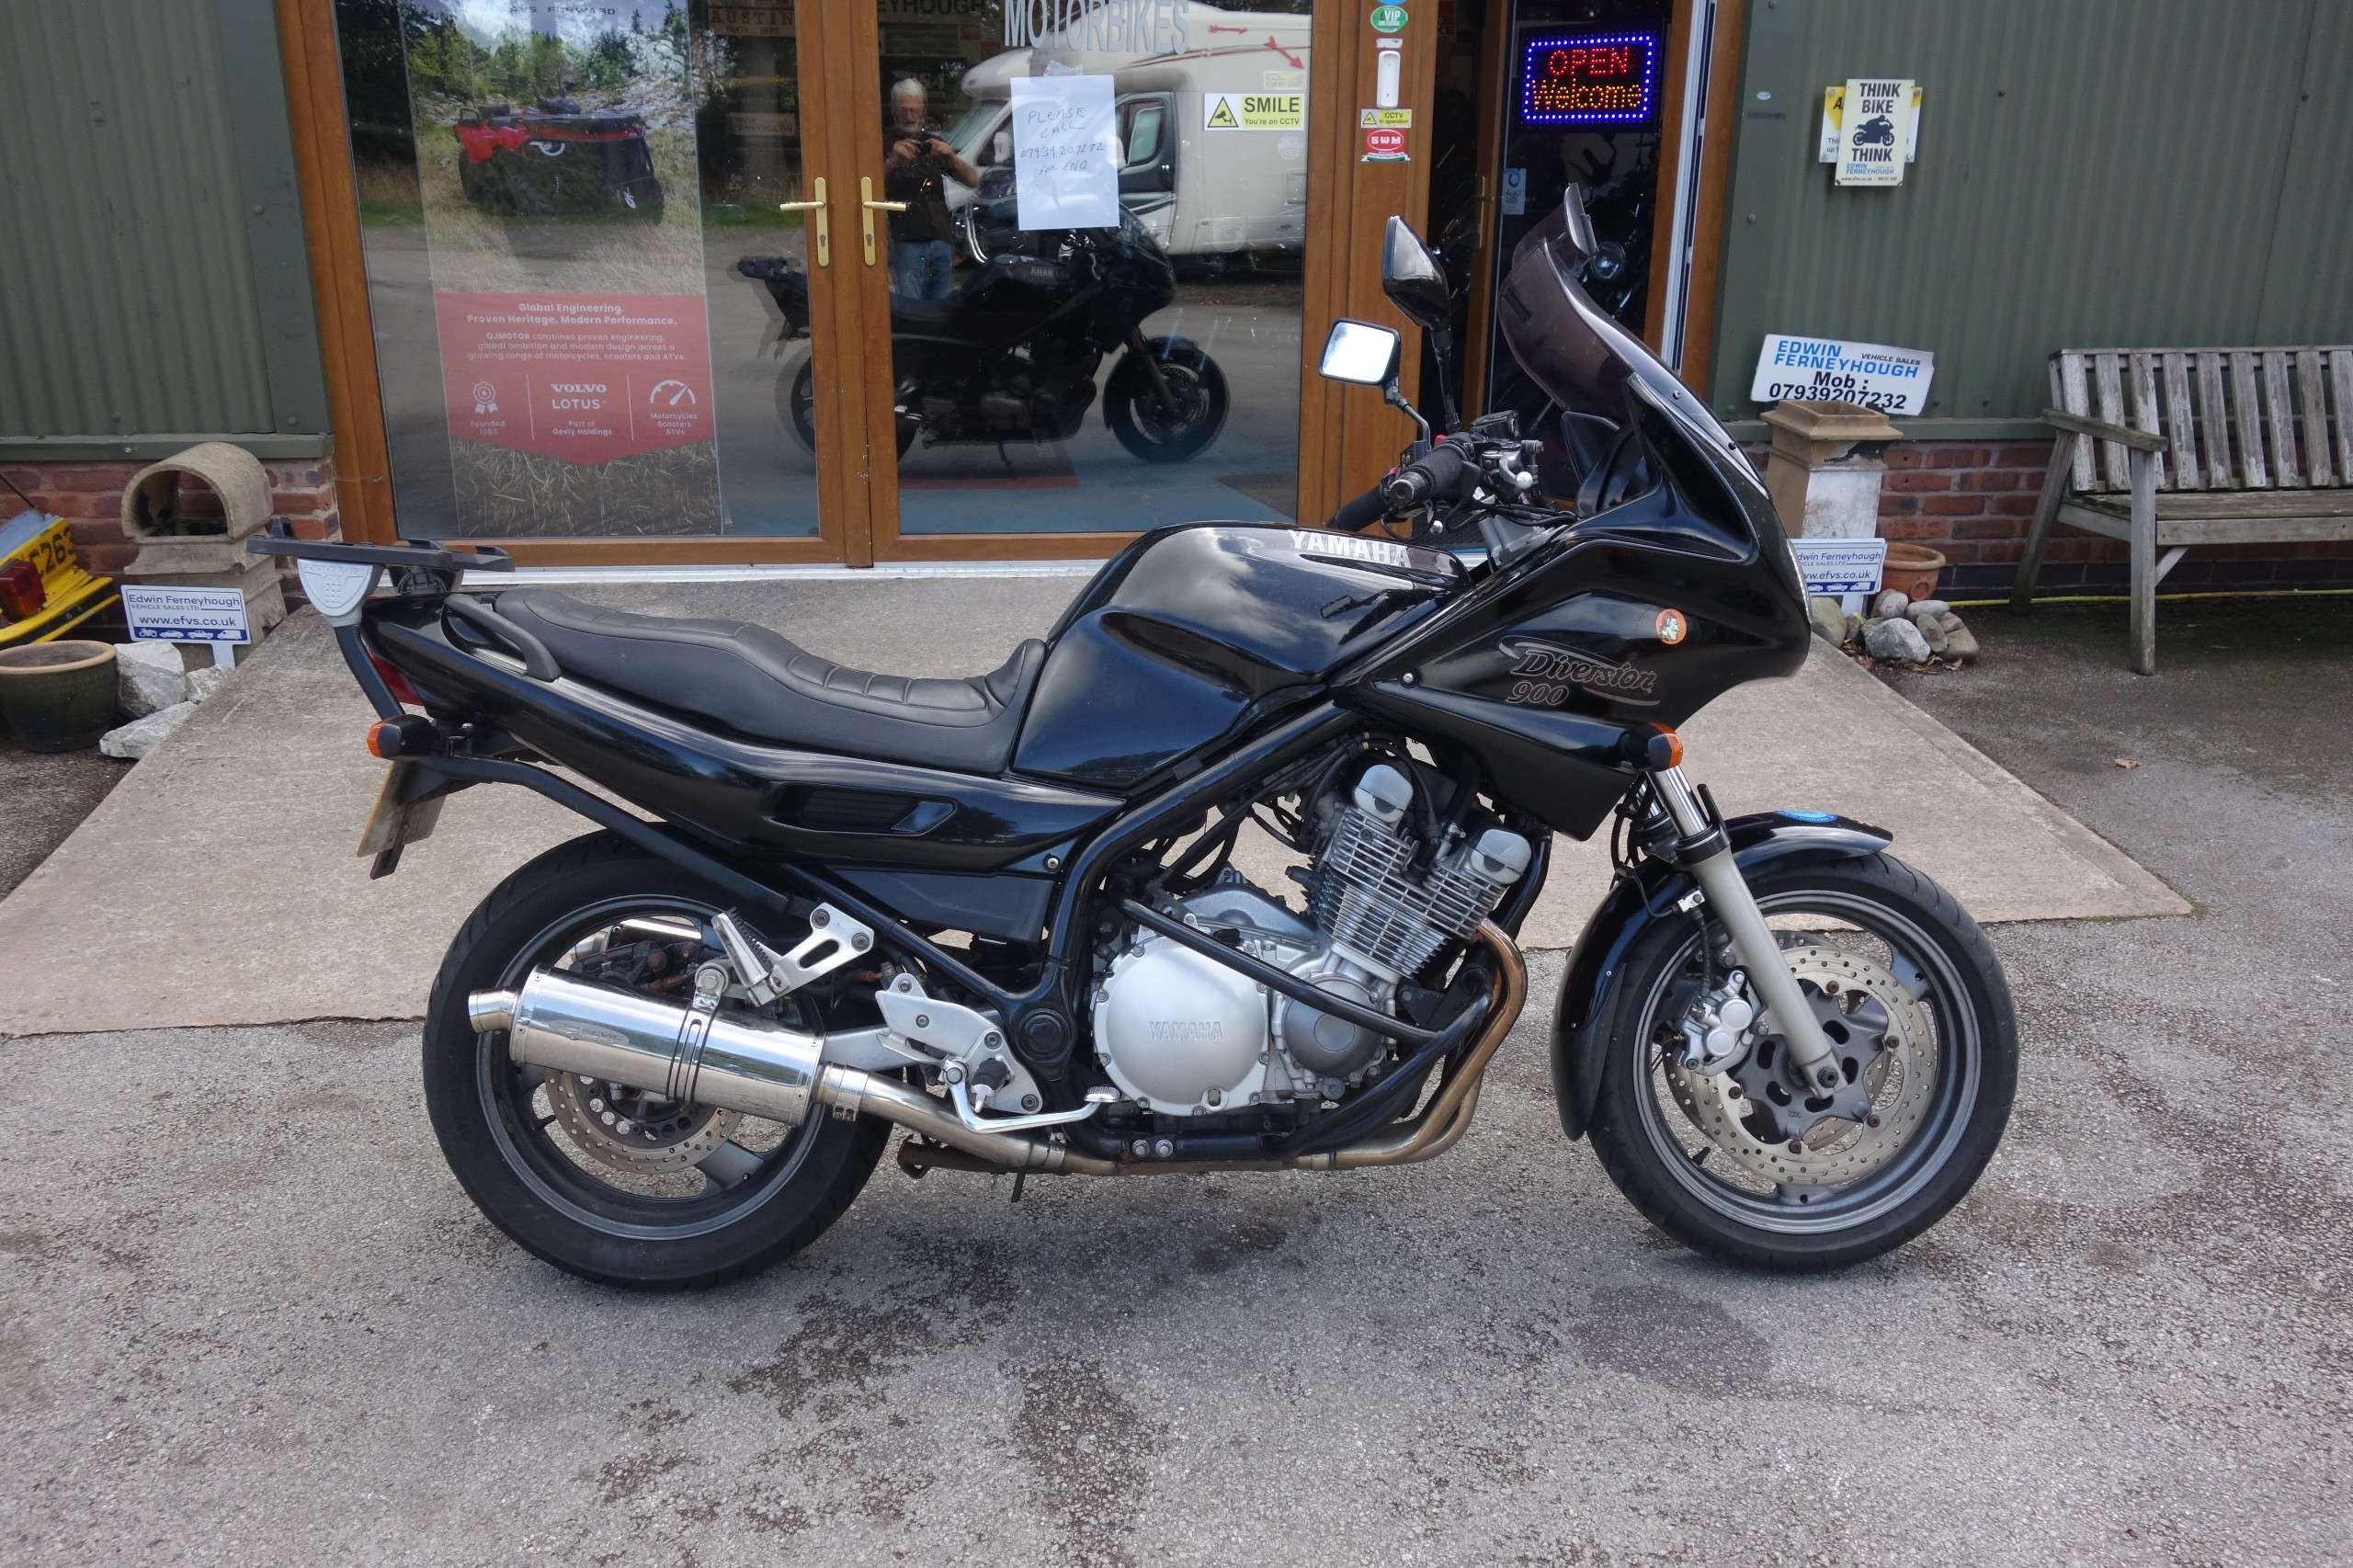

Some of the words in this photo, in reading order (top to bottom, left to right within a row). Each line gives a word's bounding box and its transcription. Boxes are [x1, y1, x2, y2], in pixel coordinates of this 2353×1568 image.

[710, 10, 794, 25] AUSTIN
[1383, 9, 1402, 22] VIP
[1005, 0, 1189, 54] MOTORBIKES
[1548, 46, 1631, 75] OPEN
[1530, 77, 1643, 111] Welcome
[1859, 83, 1902, 97] THINK
[1244, 97, 1301, 112] SMILE
[1861, 99, 1894, 113] BIKE
[1370, 136, 1402, 144] SWM
[1851, 148, 1893, 163] THINK
[518, 302, 554, 312] Global
[556, 303, 624, 314] Engineering.
[467, 314, 506, 324] Proven
[507, 314, 558, 325] Heritage.
[561, 315, 601, 324] Modern
[604, 315, 676, 325] Performance.
[486, 332, 530, 340] QJMOTOR
[477, 342, 506, 351] global
[508, 342, 548, 350] ambition
[551, 342, 567, 350] and
[606, 343, 636, 352] design
[1778, 340, 1842, 357] EDWIN
[469, 352, 504, 360] growing
[506, 352, 532, 360] range
[1861, 353, 1893, 362] VEHICLE
[1895, 358, 1921, 366] SALES
[1774, 353, 1918, 379] FERNEYHOUGH
[1813, 370, 1856, 389] Mob
[551, 384, 608, 393] VOLVO
[1768, 382, 1907, 410] 07939207232
[551, 399, 601, 410] LOTUS
[650, 412, 699, 421] Motorcycles
[552, 427, 575, 436] Geely
[576, 428, 612, 437] Holdings
[1287, 528, 1412, 569] YAMAHA
[1798, 552, 1819, 561] dwin
[1821, 552, 1881, 562] Ferneyhough
[1803, 570, 1870, 580] ww.efvs.co.uk
[129, 594, 164, 603] Edwin
[165, 596, 240, 607] Ferneyhough
[138, 615, 236, 626] www.efvs.co.uk
[1510, 649, 1658, 694] Diversion
[1506, 680, 1571, 706] 900
[1148, 1021, 1223, 1041] YAMAHA
